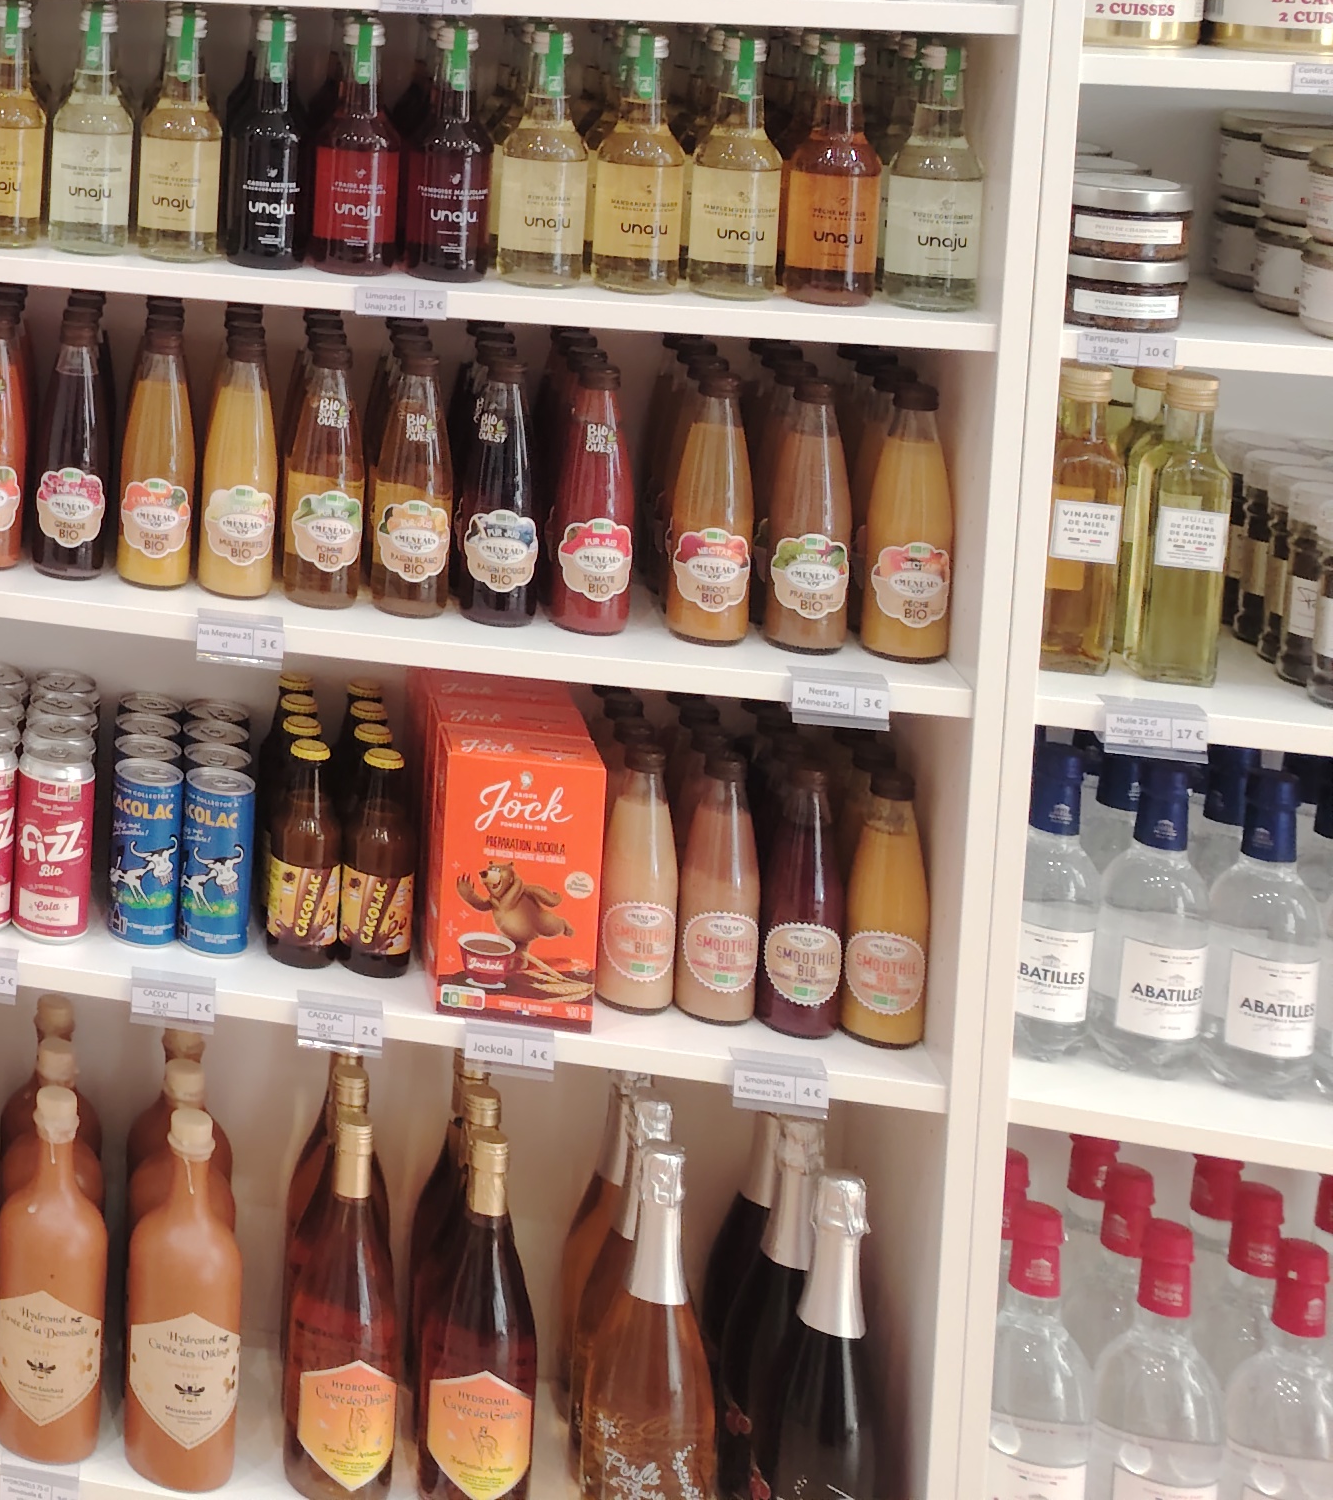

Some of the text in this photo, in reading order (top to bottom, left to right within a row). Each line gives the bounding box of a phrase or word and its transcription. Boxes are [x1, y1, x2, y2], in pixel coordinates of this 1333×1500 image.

[1095, 4, 1175, 17] 2 CUISSES
[68, 186, 111, 201] unaju
[248, 200, 295, 218] unaju
[430, 207, 478, 225] unaju
[524, 215, 571, 231] unaju
[917, 235, 967, 252] unaju
[365, 291, 406, 302] Limonades
[418, 299, 443, 311] 3,5 €
[1084, 334, 1129, 345] Tartinades
[1145, 347, 1170, 358] 10 €
[1063, 510, 1116, 522] VINAIGRE
[1181, 515, 1215, 525] HUILE
[59, 529, 79, 541] BIO
[1076, 528, 1109, 537] SAFRAN
[800, 599, 823, 612] BIO
[904, 608, 927, 620] BIO
[808, 687, 839, 698] Nectars
[798, 697, 831, 708] Meneau
[863, 698, 882, 710] 3 €
[1176, 729, 1204, 740] 17 €
[475, 778, 573, 832] Jock
[295, 874, 322, 937] CACOLAC
[360, 881, 389, 944] CACOLAC
[695, 934, 754, 952] SMOOTHIE
[776, 946, 835, 966] SMOOTHIE
[1131, 982, 1203, 1002] ABATILLES
[1240, 997, 1315, 1018] ABATILLES
[473, 1042, 513, 1057] Jockola
[743, 1075, 785, 1088] Smoothies
[738, 1085, 771, 1098] Meneau
[803, 1087, 821, 1099] 4 €
[166, 1330, 215, 1346] Hydromel
[332, 1380, 381, 1391] HYDROMEL
